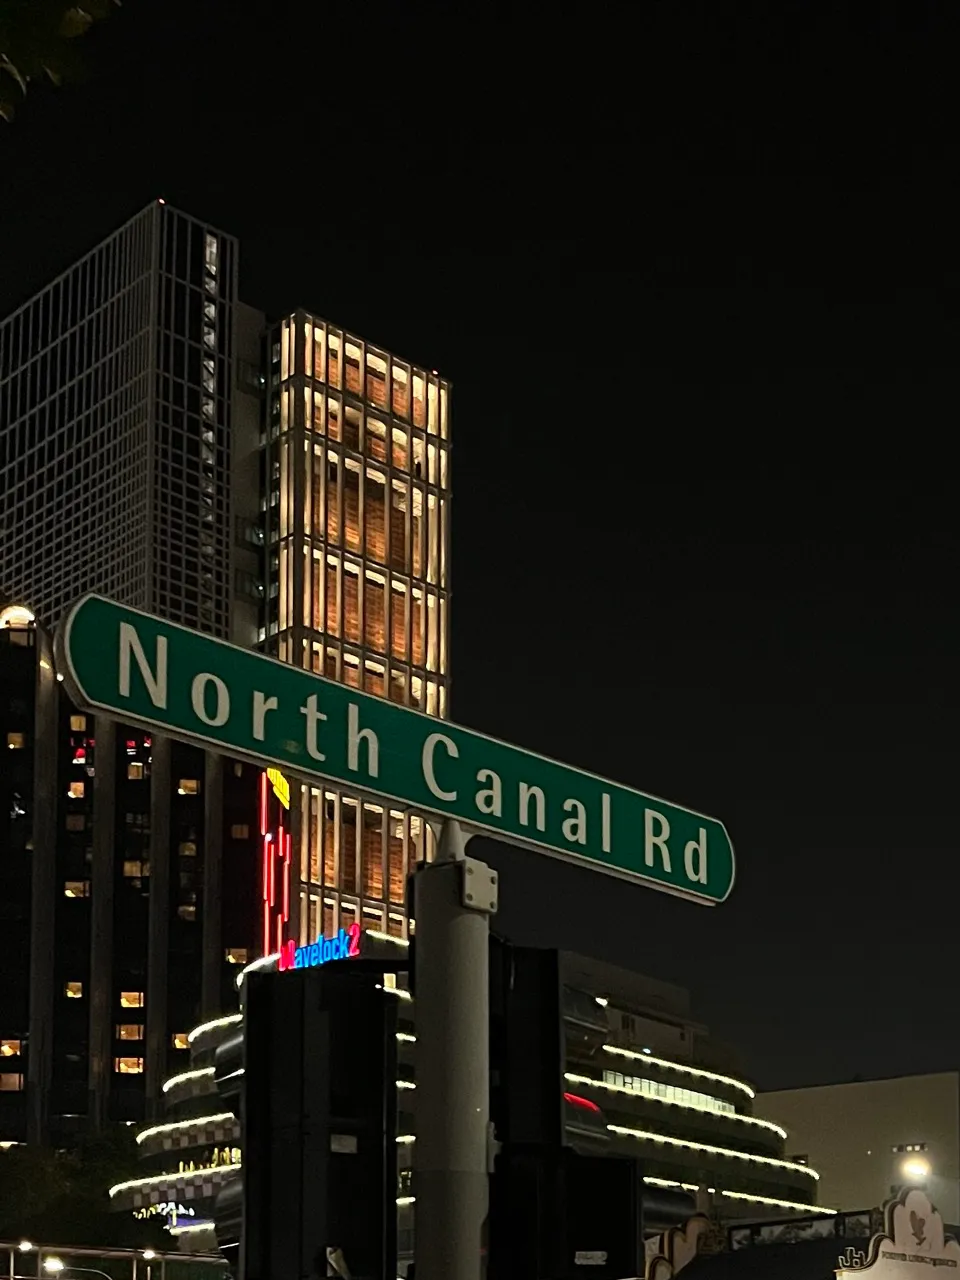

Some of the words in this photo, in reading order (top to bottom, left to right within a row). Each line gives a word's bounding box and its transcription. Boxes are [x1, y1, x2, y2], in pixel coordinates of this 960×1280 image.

[118, 620, 380, 778] North
[421, 731, 612, 854] Canal
[644, 808, 709, 886] Rd
